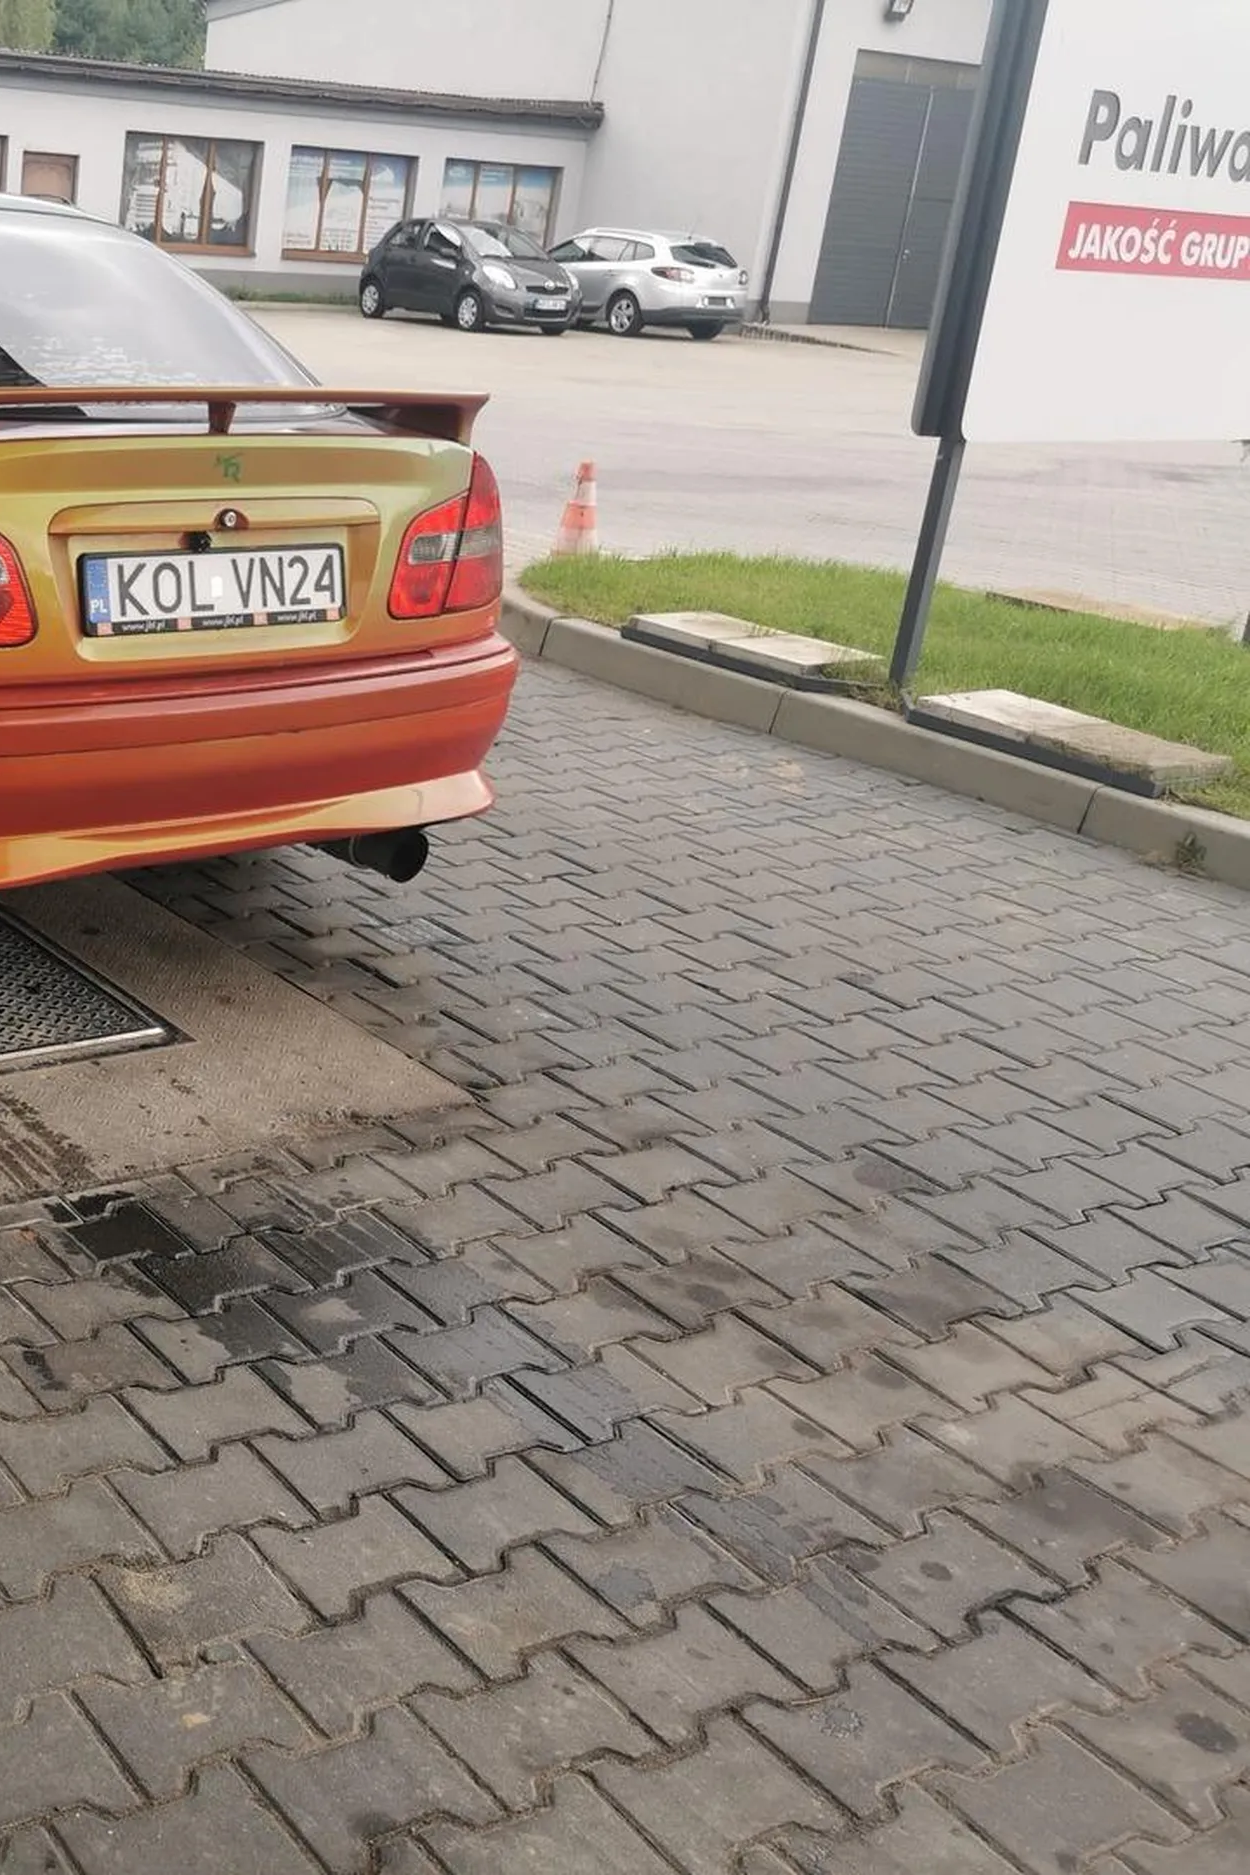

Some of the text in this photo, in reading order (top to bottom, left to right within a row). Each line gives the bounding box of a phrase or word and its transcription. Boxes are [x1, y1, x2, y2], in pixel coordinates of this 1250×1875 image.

[1078, 89, 1250, 182] Paliwa
[1068, 217, 1177, 265] JAKOŚĆ
[90, 599, 108, 614] PL
[117, 554, 336, 616] KOL VN24
